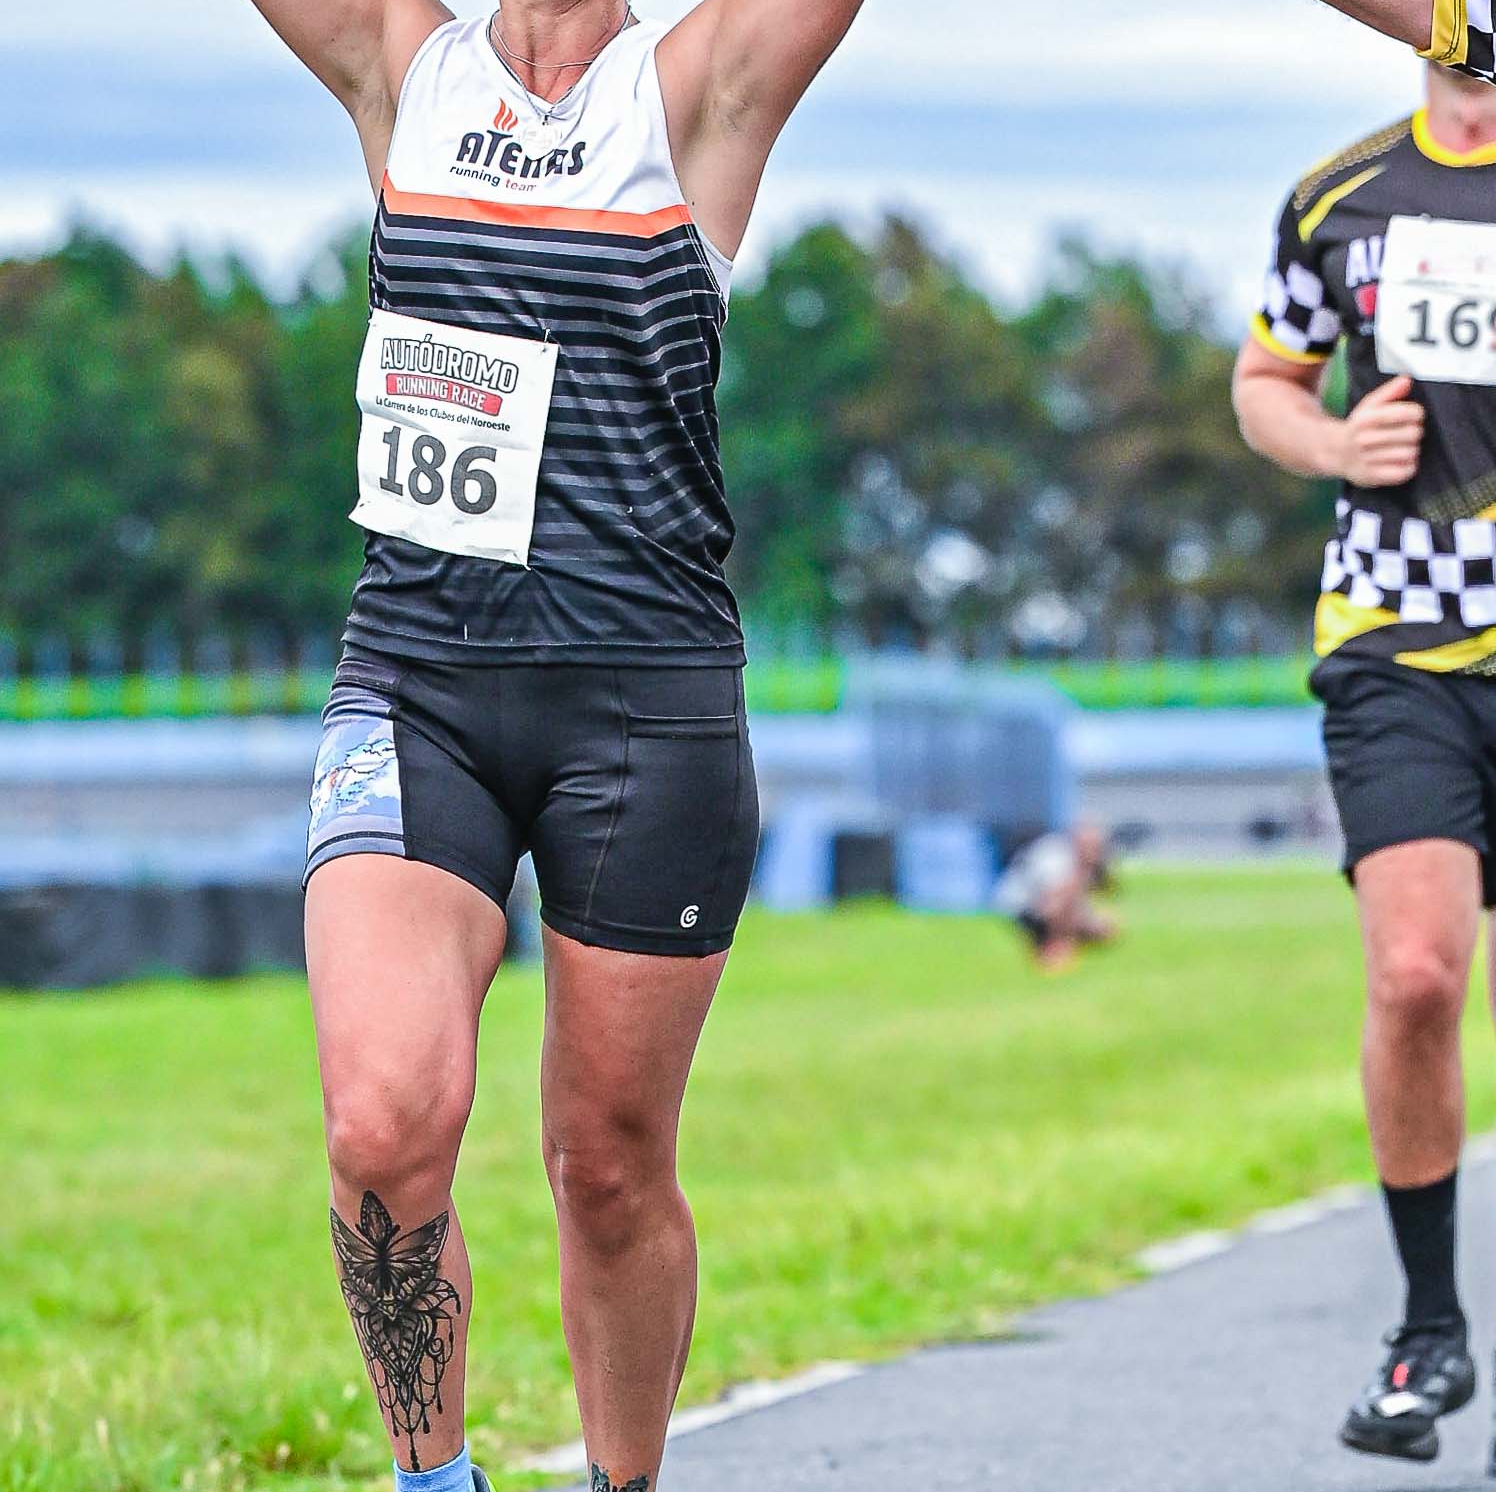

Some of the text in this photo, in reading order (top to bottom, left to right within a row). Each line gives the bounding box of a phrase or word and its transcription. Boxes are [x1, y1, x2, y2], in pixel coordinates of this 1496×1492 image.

[450, 166, 501, 188] running
[381, 334, 519, 394] AUTÓDROMO
[396, 376, 487, 411] RUNNING RACE
[375, 396, 511, 432] La Carrera de los Clubes del Noroeste
[379, 425, 498, 515] 186
